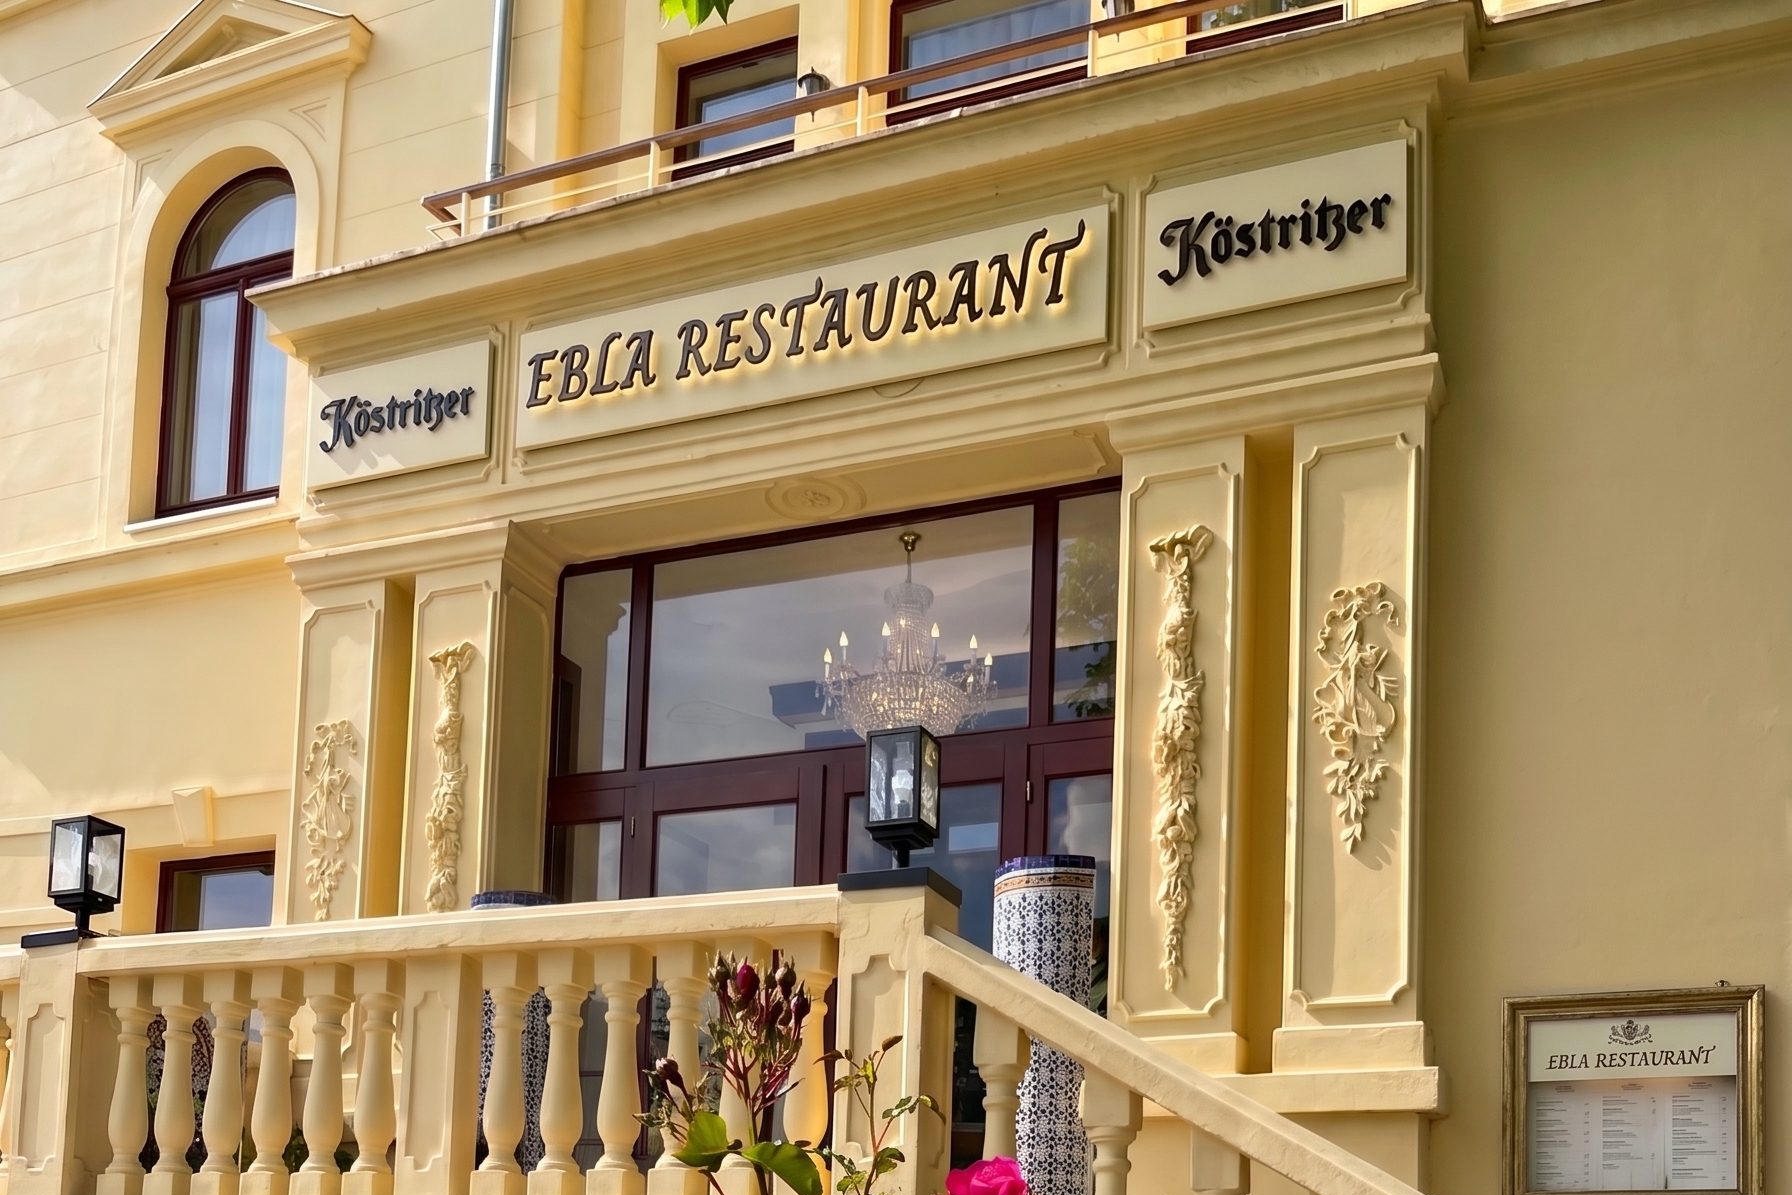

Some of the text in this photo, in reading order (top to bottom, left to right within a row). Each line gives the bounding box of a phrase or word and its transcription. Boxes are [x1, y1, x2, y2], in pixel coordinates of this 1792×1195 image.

[1157, 192, 1392, 287] Köstritzer
[525, 218, 1086, 409] EBLA RESTAURANT
[318, 386, 475, 453] Köstritzer
[1545, 1045, 1717, 1071] EBLA RESTAURANT
